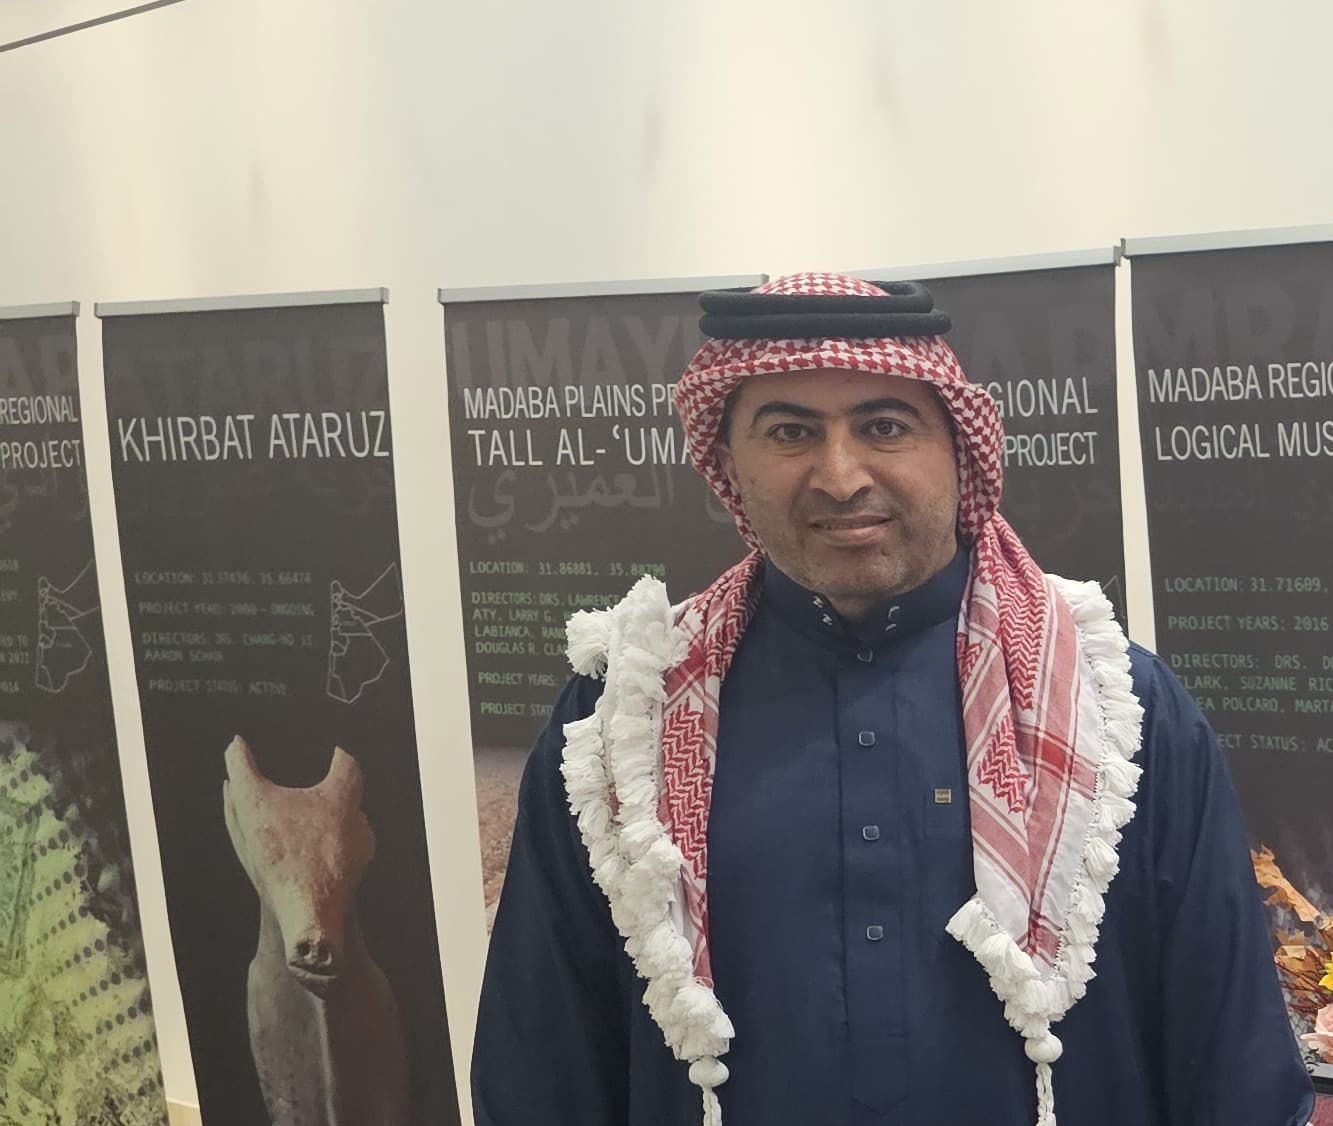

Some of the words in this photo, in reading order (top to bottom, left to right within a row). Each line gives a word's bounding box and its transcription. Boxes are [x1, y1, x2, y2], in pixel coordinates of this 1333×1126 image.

[1147, 365, 1262, 404] MADABA
[0, 395, 79, 424] REGIONAL
[463, 384, 561, 420] MADABA
[564, 383, 647, 418] PLAINS
[117, 413, 255, 463] KHIRBAT
[268, 410, 390, 460] ATARUZ
[1155, 424, 1271, 461] LOGICAL
[0, 439, 81, 470] PROJECT
[467, 427, 544, 467] TALL
[555, 426, 607, 466] AL-
[1004, 431, 1098, 468] PROJECT
[469, 561, 529, 576] LOCATION:
[1164, 576, 1244, 593] LOCATION:
[471, 591, 537, 606] DIRECTORS:
[508, 608, 538, 623] LARRY
[1167, 615, 1231, 631] PROJECT
[1237, 616, 1286, 632] YEARS:
[1293, 616, 1329, 632] 2016
[475, 642, 526, 655] DOUGLAS
[1171, 654, 1261, 669] DIRECTORS:
[1274, 655, 1308, 670] DRS.
[478, 672, 523, 685] PROJECT
[1240, 675, 1297, 692] SUZANNE
[480, 703, 526, 716] PROJECT
[1250, 735, 1306, 751] STATUS:
